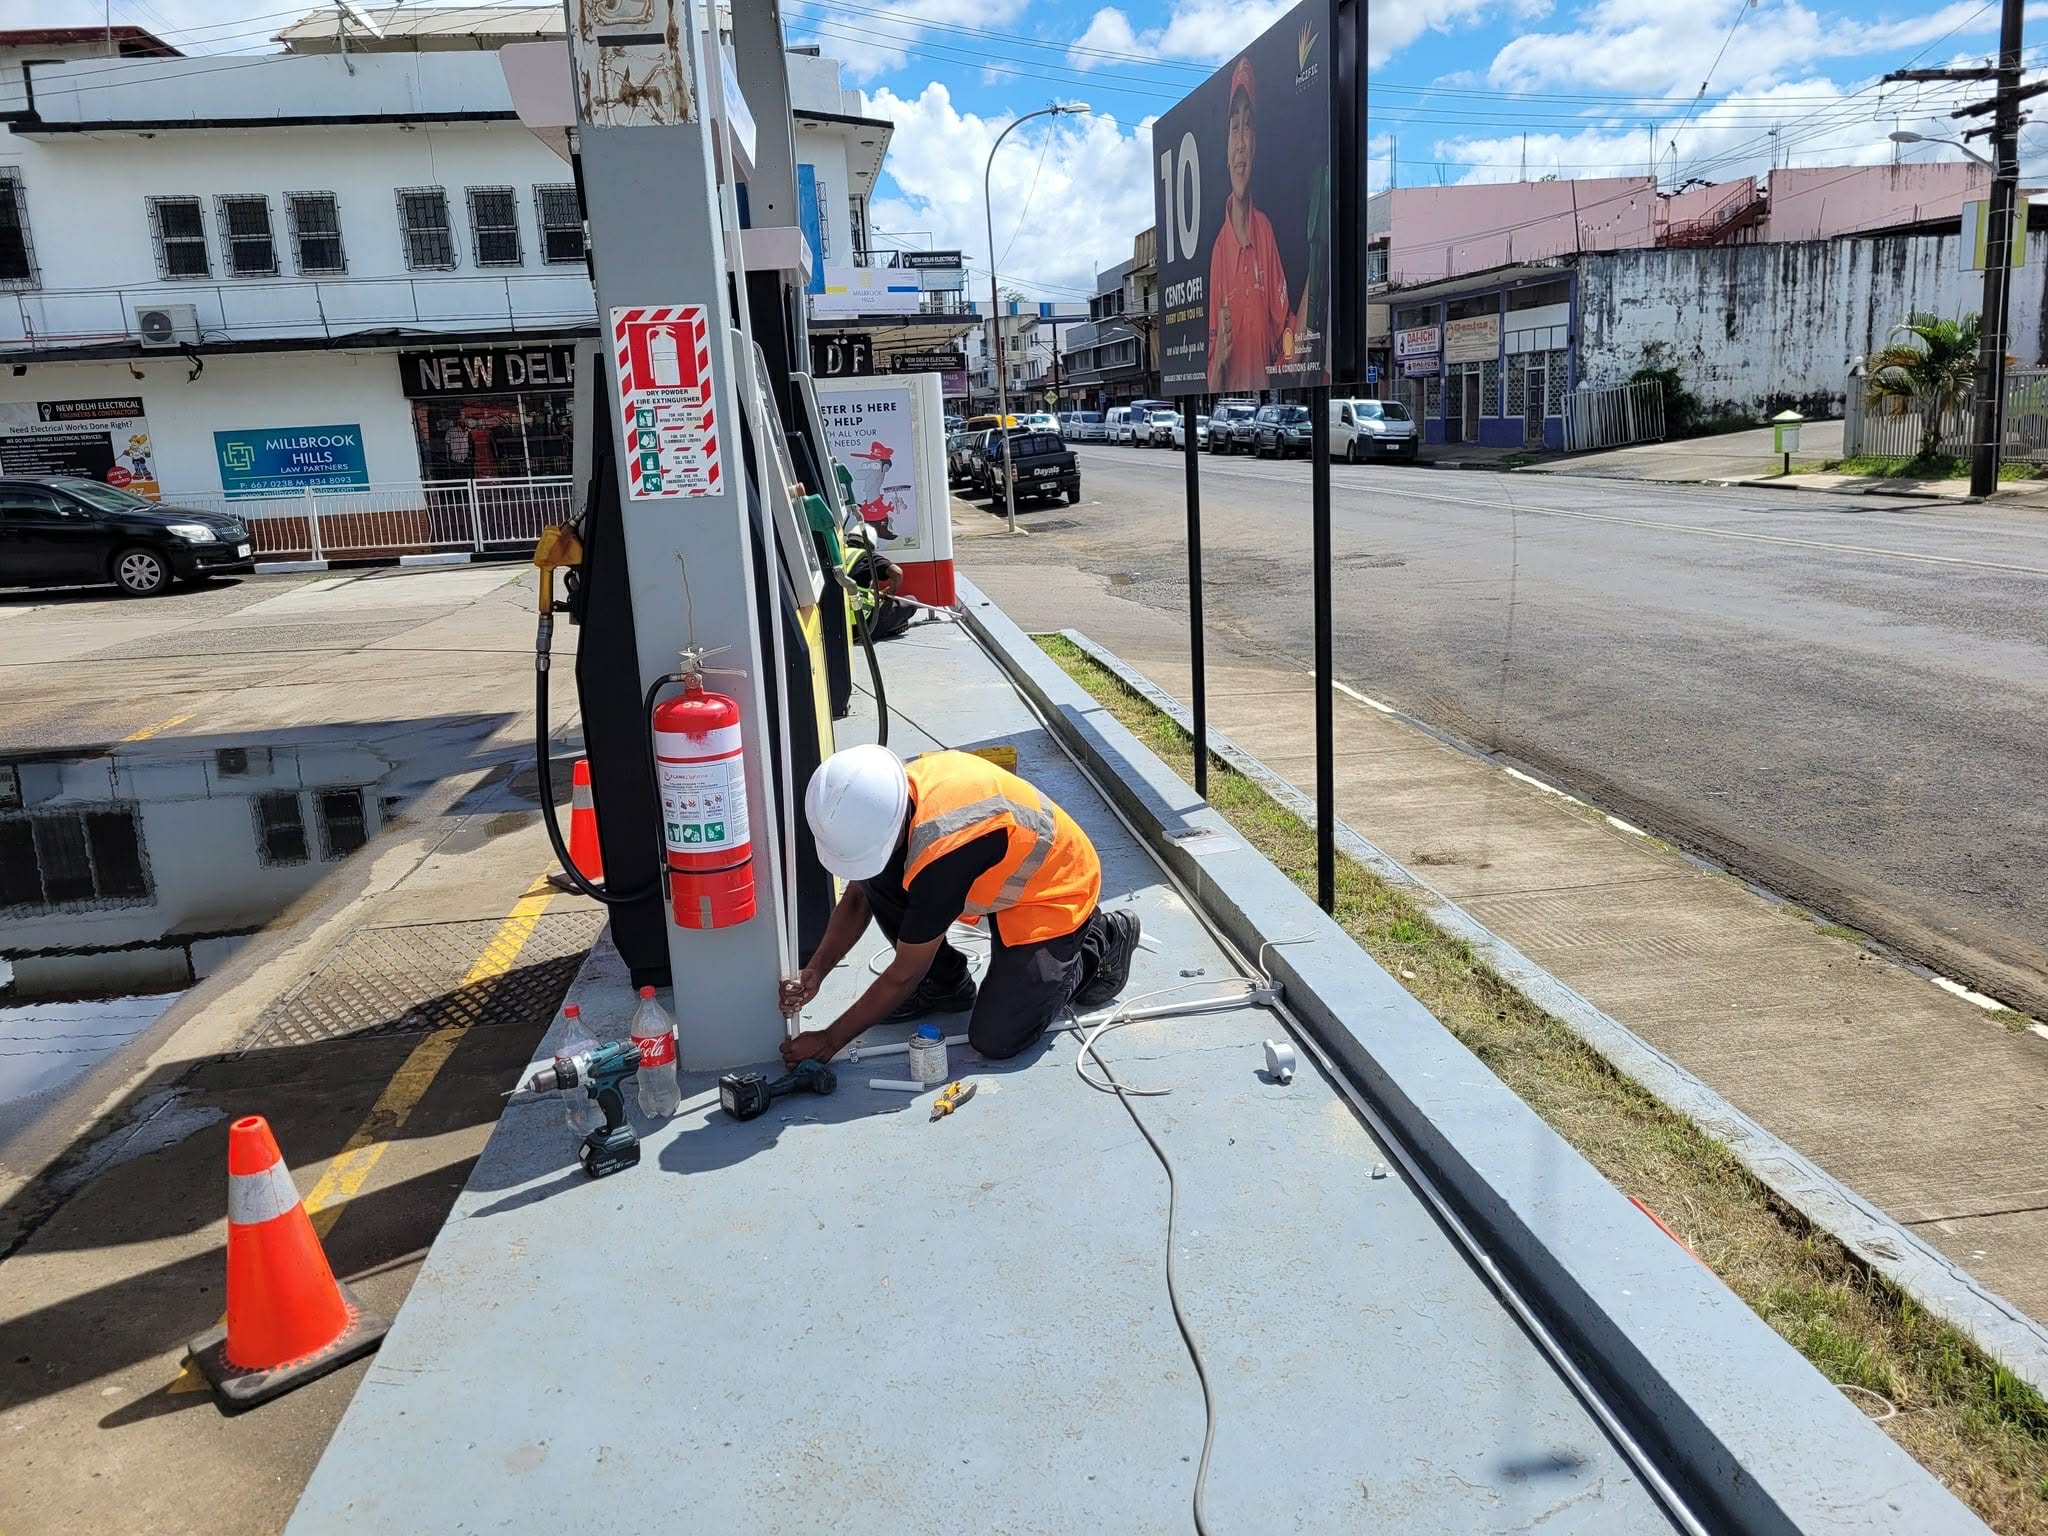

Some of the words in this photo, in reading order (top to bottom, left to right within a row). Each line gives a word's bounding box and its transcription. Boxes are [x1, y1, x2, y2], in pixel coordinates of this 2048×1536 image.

[1161, 131, 1200, 264] 10
[1165, 282, 1186, 308] CENTS
[1186, 276, 1203, 303] OFF!
[1187, 308, 1196, 320] YOU
[419, 356, 493, 390] NEW
[1282, 362, 1306, 373] CONDITIONS
[56, 404, 74, 412] NEW
[75, 402, 97, 411] DELHI
[98, 400, 140, 410] ELECTRICAL
[852, 404, 863, 413] IS
[868, 402, 897, 412] HERE
[10, 426, 29, 434] Need
[30, 424, 64, 432] Electrical
[66, 422, 88, 432] Works
[90, 422, 109, 430] Done
[110, 420, 133, 430] Right?
[834, 416, 863, 426] HELP
[854, 428, 877, 436] YOUR
[266, 434, 356, 450] MILLBROOK
[834, 439, 861, 447] NEEDS
[292, 452, 333, 464] HILLS
[304, 464, 349, 472] PARTNERS
[1034, 466, 1060, 476] Dayals
[638, 1036, 666, 1058] Cola
